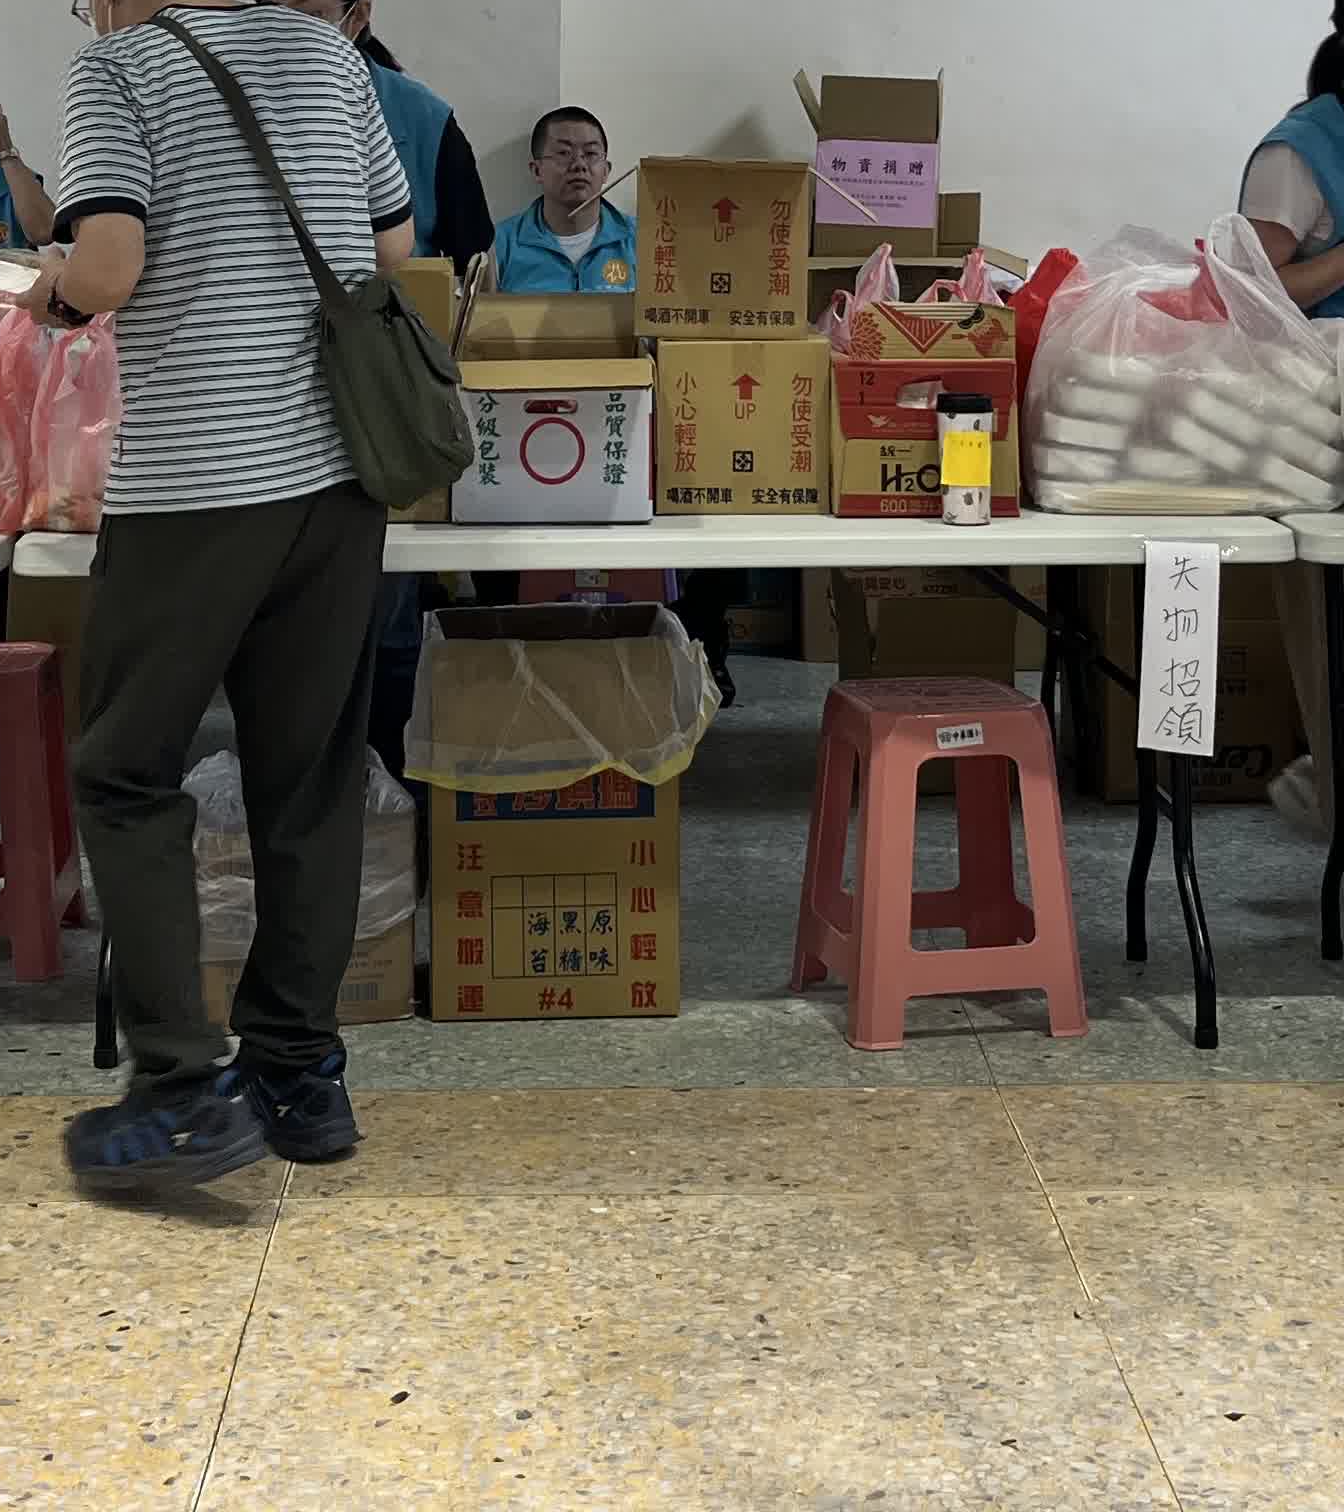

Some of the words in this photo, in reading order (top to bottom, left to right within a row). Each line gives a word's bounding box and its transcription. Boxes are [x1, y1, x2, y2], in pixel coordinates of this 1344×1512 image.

[831, 157, 925, 176] 物資捐贈
[654, 196, 677, 294] 小心輕放
[713, 225, 735, 242] UP
[768, 199, 791, 295] 勿使受潮
[644, 307, 710, 325] 喝酒不開車
[729, 310, 795, 326] 安全有保障
[859, 371, 875, 386] 12
[475, 392, 502, 486] 分級包裝
[602, 392, 628, 485] 品質保證
[674, 373, 697, 473] 小心輕放
[734, 402, 756, 420] UP
[790, 374, 813, 473] 勿使受潮
[667, 488, 733, 505] 喝酒不開車
[752, 488, 819, 506] 安全有保障
[1154, 556, 1202, 745] 失物招領
[528, 913, 551, 973] 海苔
[559, 911, 583, 972] 黑糖
[589, 910, 613, 972] 原味
[630, 840, 657, 1009] 小心輕放
[537, 986, 574, 1011] #4
